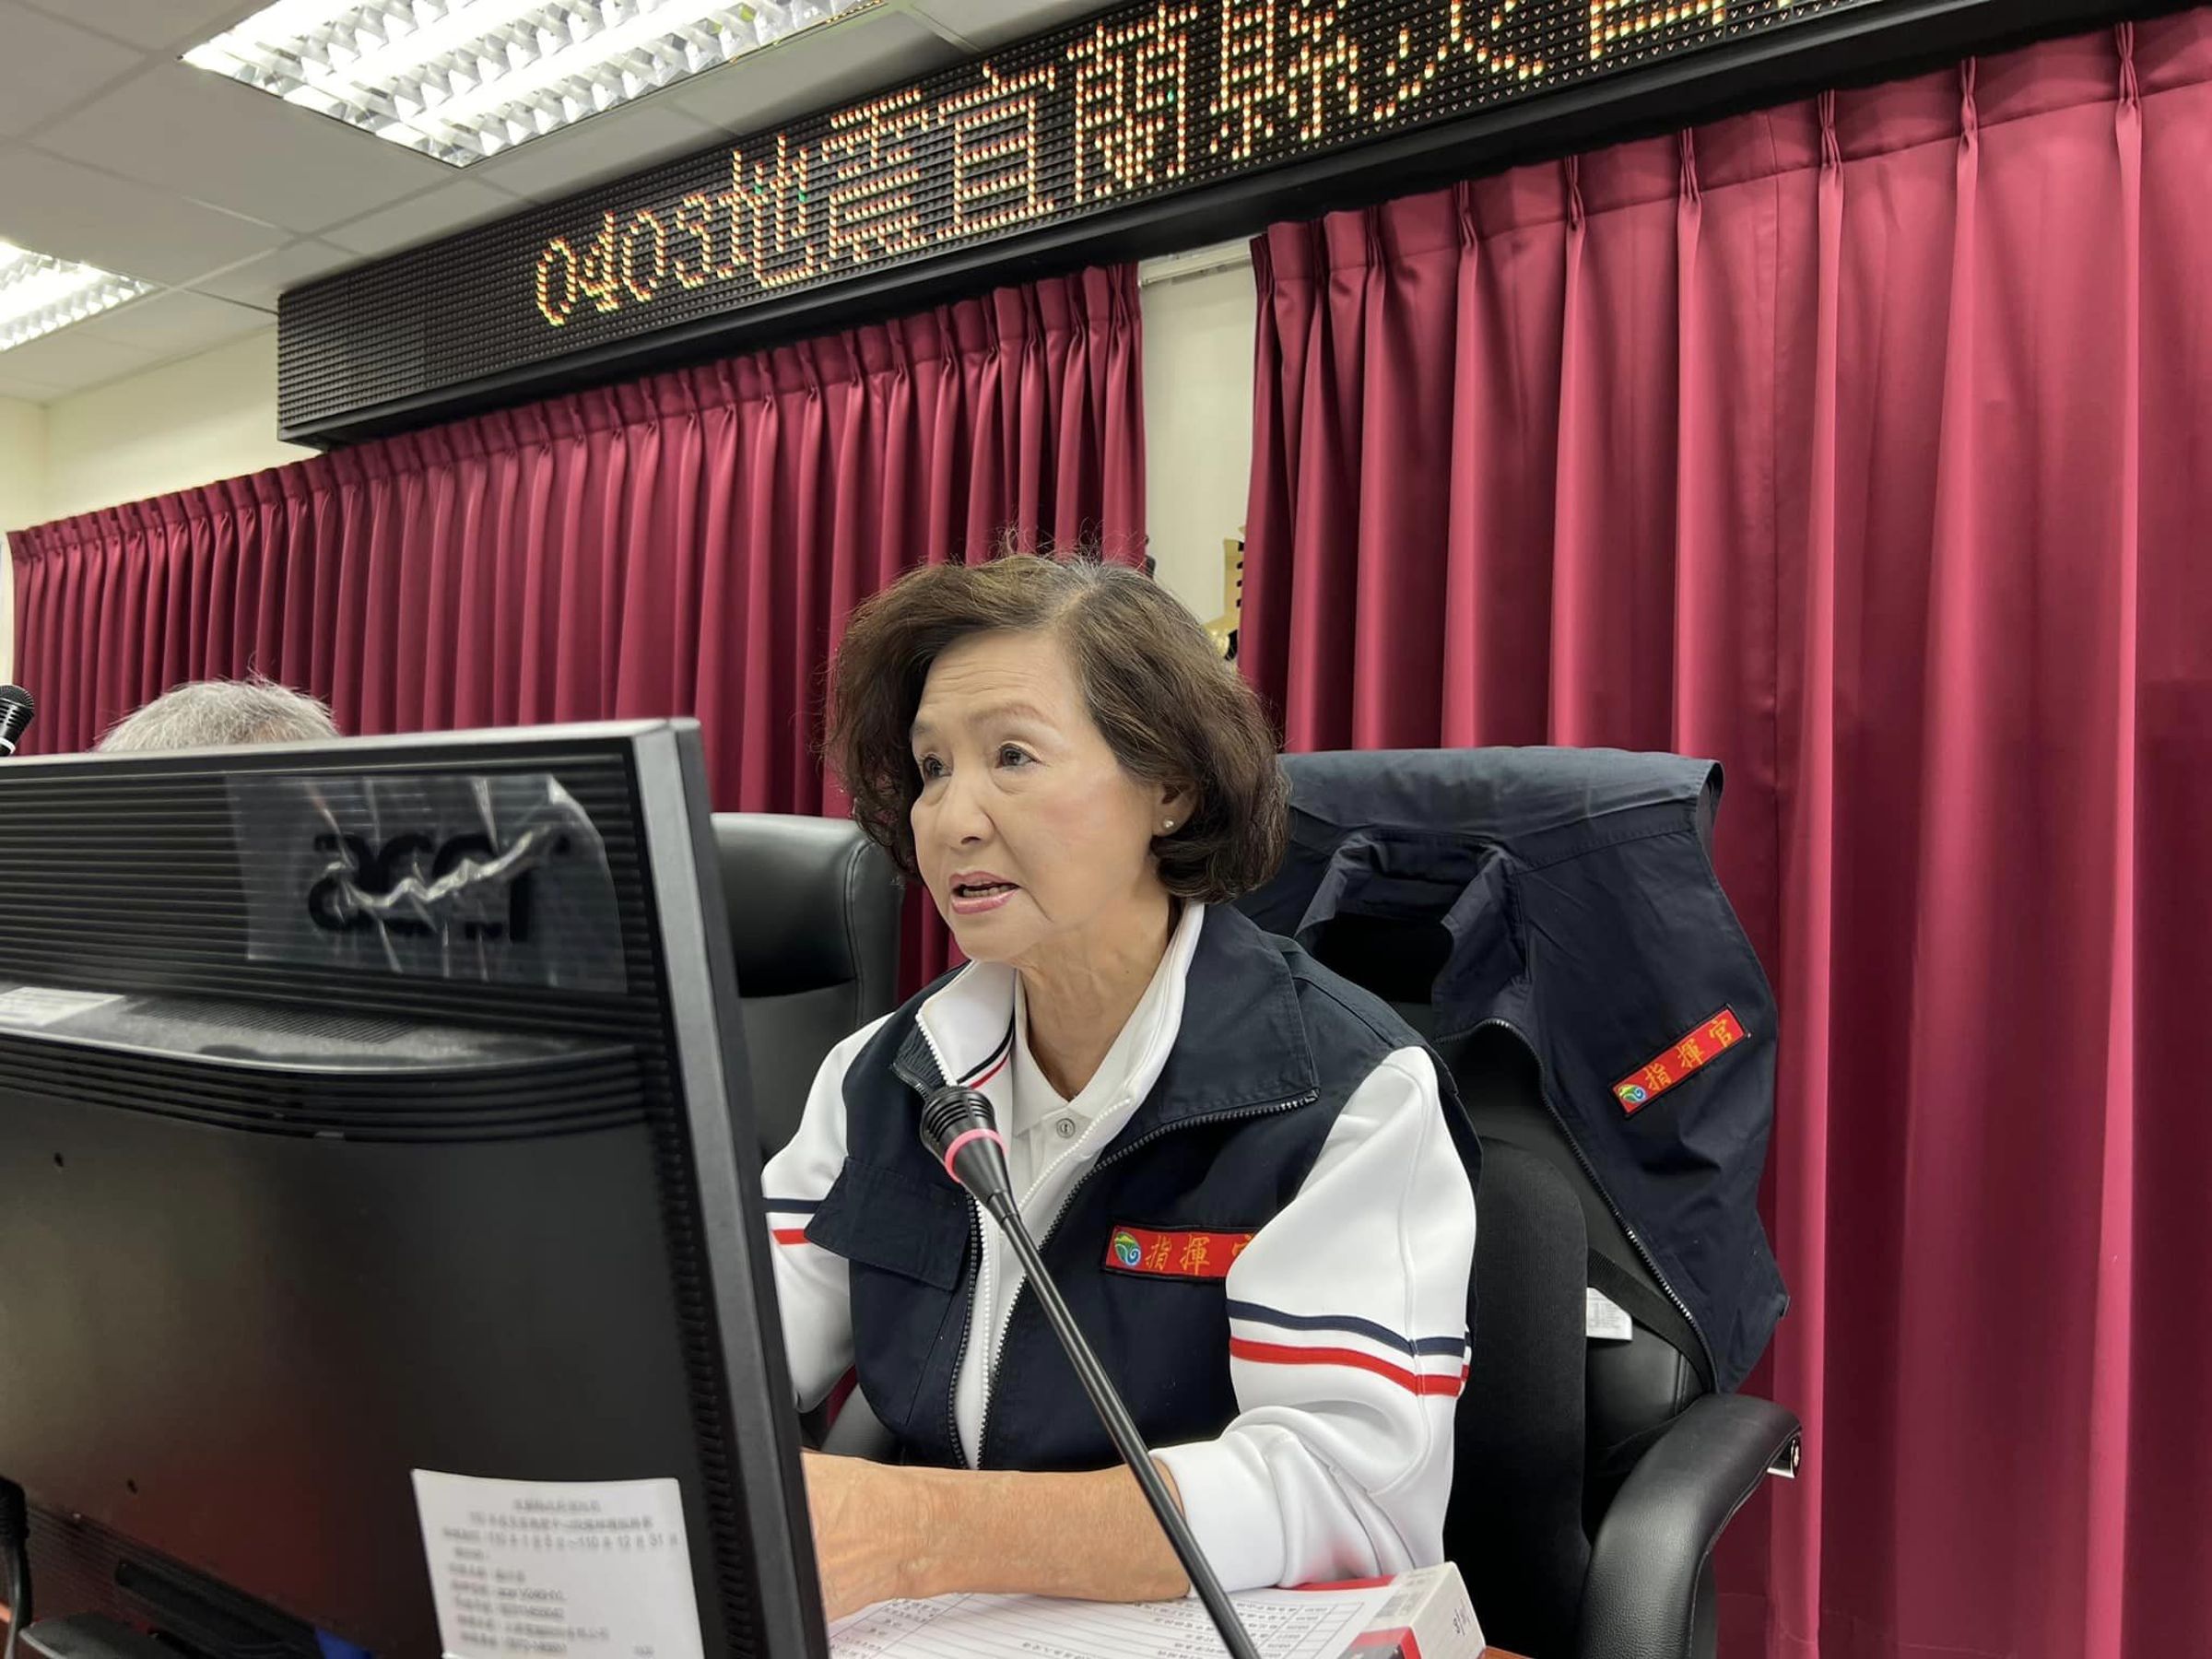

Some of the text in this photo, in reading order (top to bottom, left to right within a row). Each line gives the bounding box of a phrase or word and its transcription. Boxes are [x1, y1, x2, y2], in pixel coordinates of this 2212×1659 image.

[1644, 1018, 1733, 1091] 指揮官
[1145, 1233, 1254, 1276] 指揮
